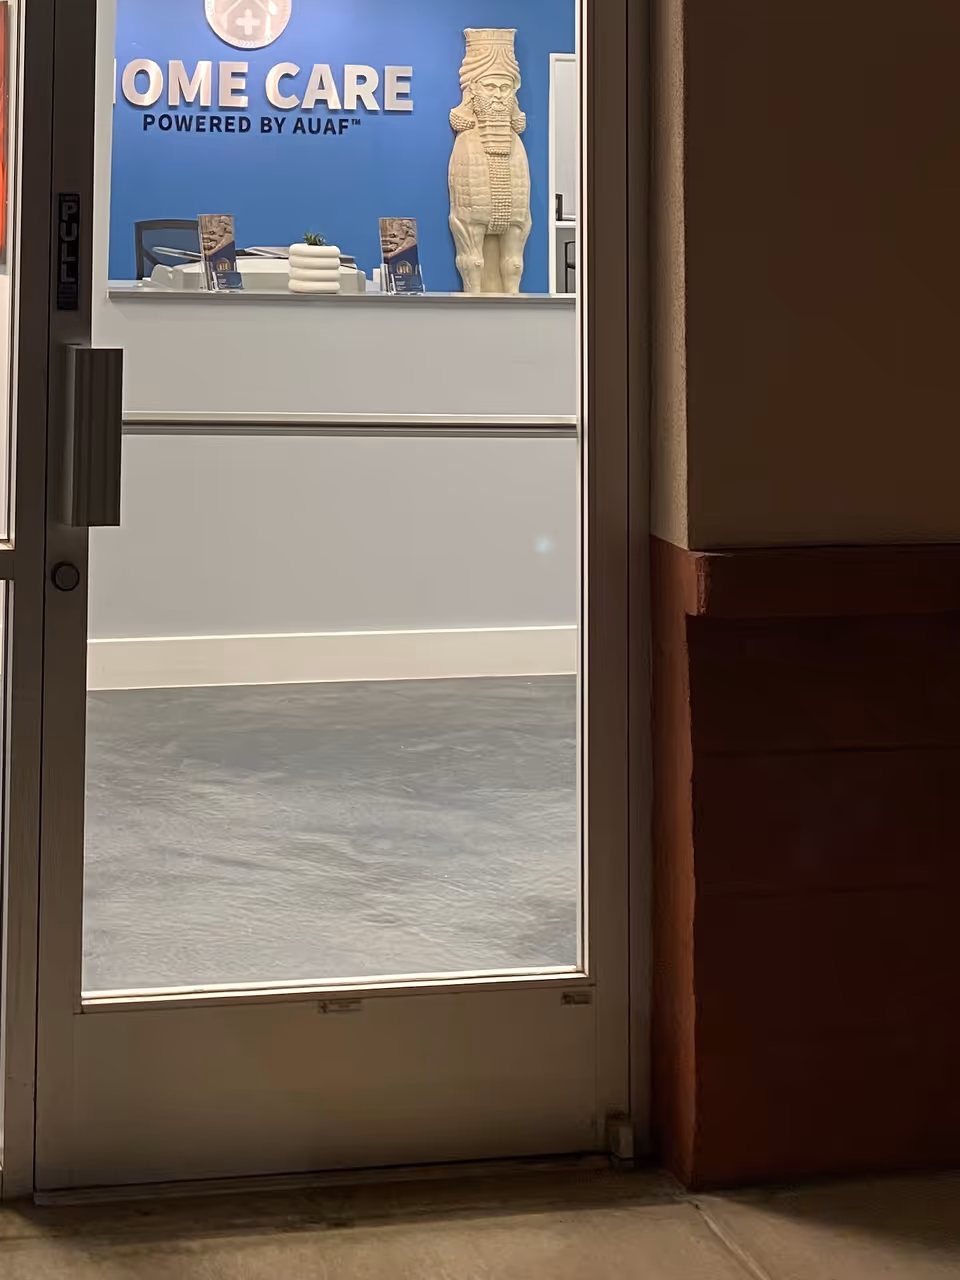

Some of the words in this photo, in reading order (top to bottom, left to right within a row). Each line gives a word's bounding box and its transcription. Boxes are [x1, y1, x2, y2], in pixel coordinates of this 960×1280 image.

[113, 58, 248, 107] OME
[265, 61, 414, 112] CARE
[142, 113, 252, 133] POWERED
[260, 115, 286, 134] BY
[59, 201, 78, 282] PULL
